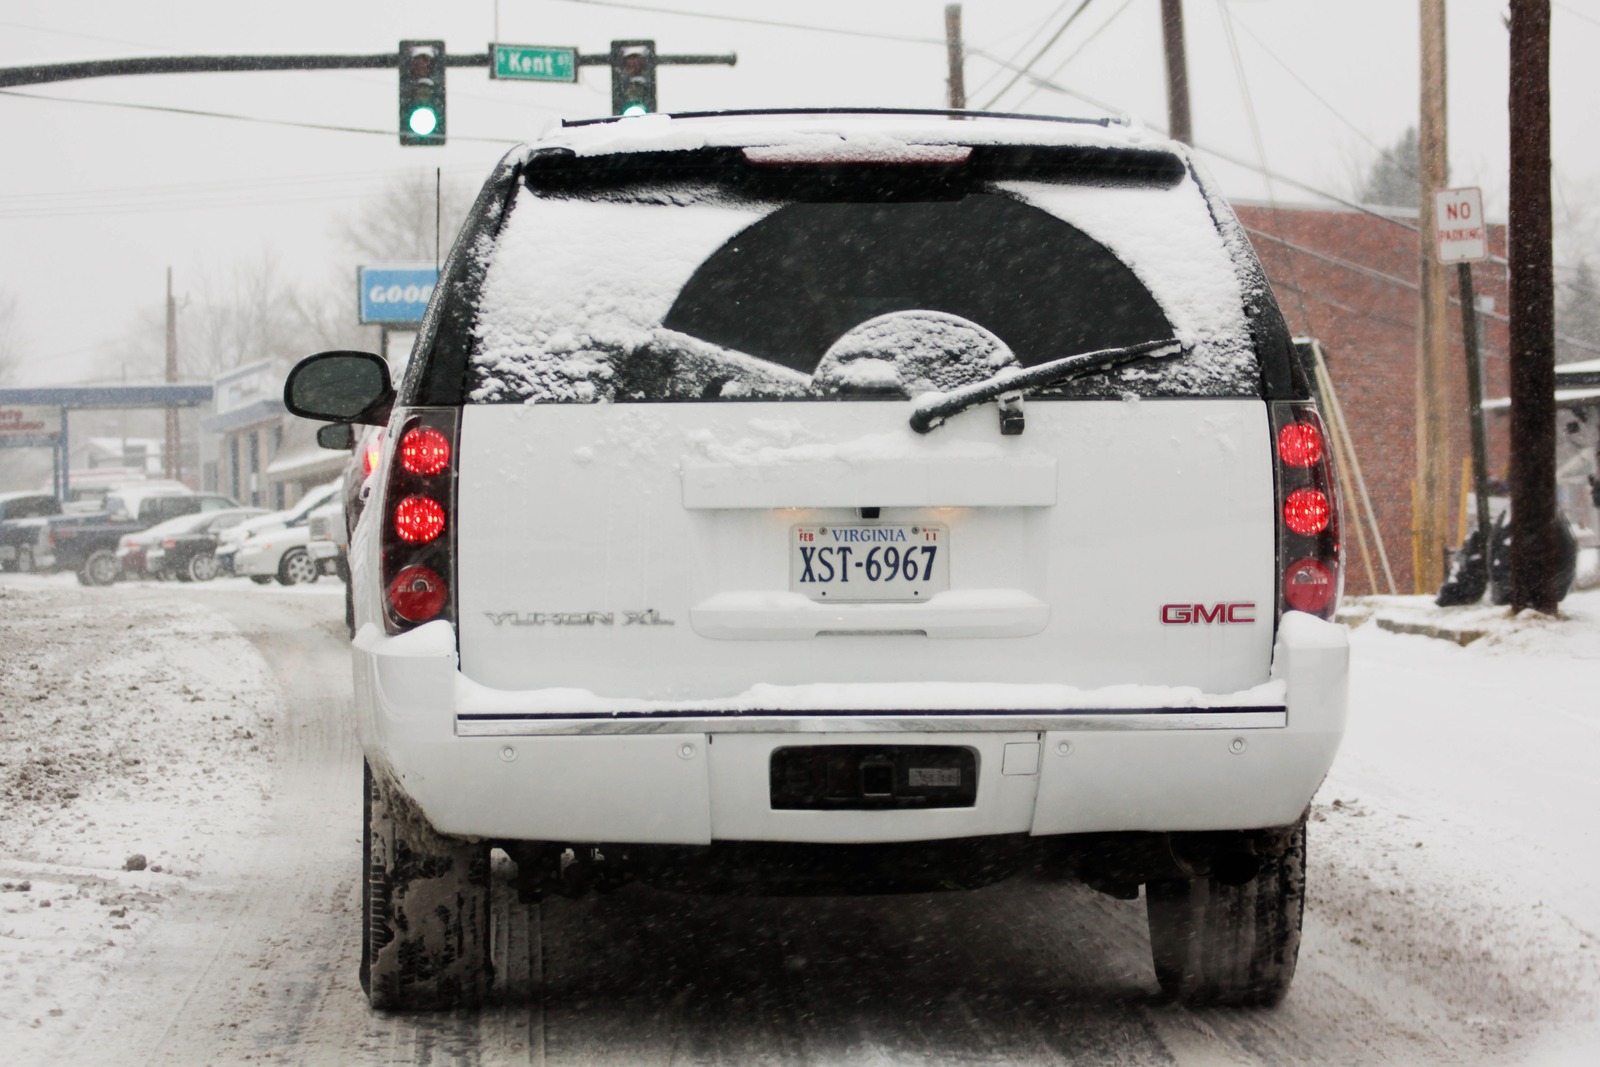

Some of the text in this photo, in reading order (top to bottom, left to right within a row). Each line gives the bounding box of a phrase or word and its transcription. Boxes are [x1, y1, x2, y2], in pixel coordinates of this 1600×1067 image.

[509, 51, 553, 75] Kent
[1445, 202, 1471, 221] NO
[1438, 226, 1485, 242] PARKING
[799, 532, 814, 542] FEB
[832, 529, 907, 542] VIRGINIA
[925, 533, 937, 541] 11
[799, 546, 938, 582] XST-6967
[482, 609, 676, 626] YUKON XL
[1161, 602, 1256, 624] GMC
